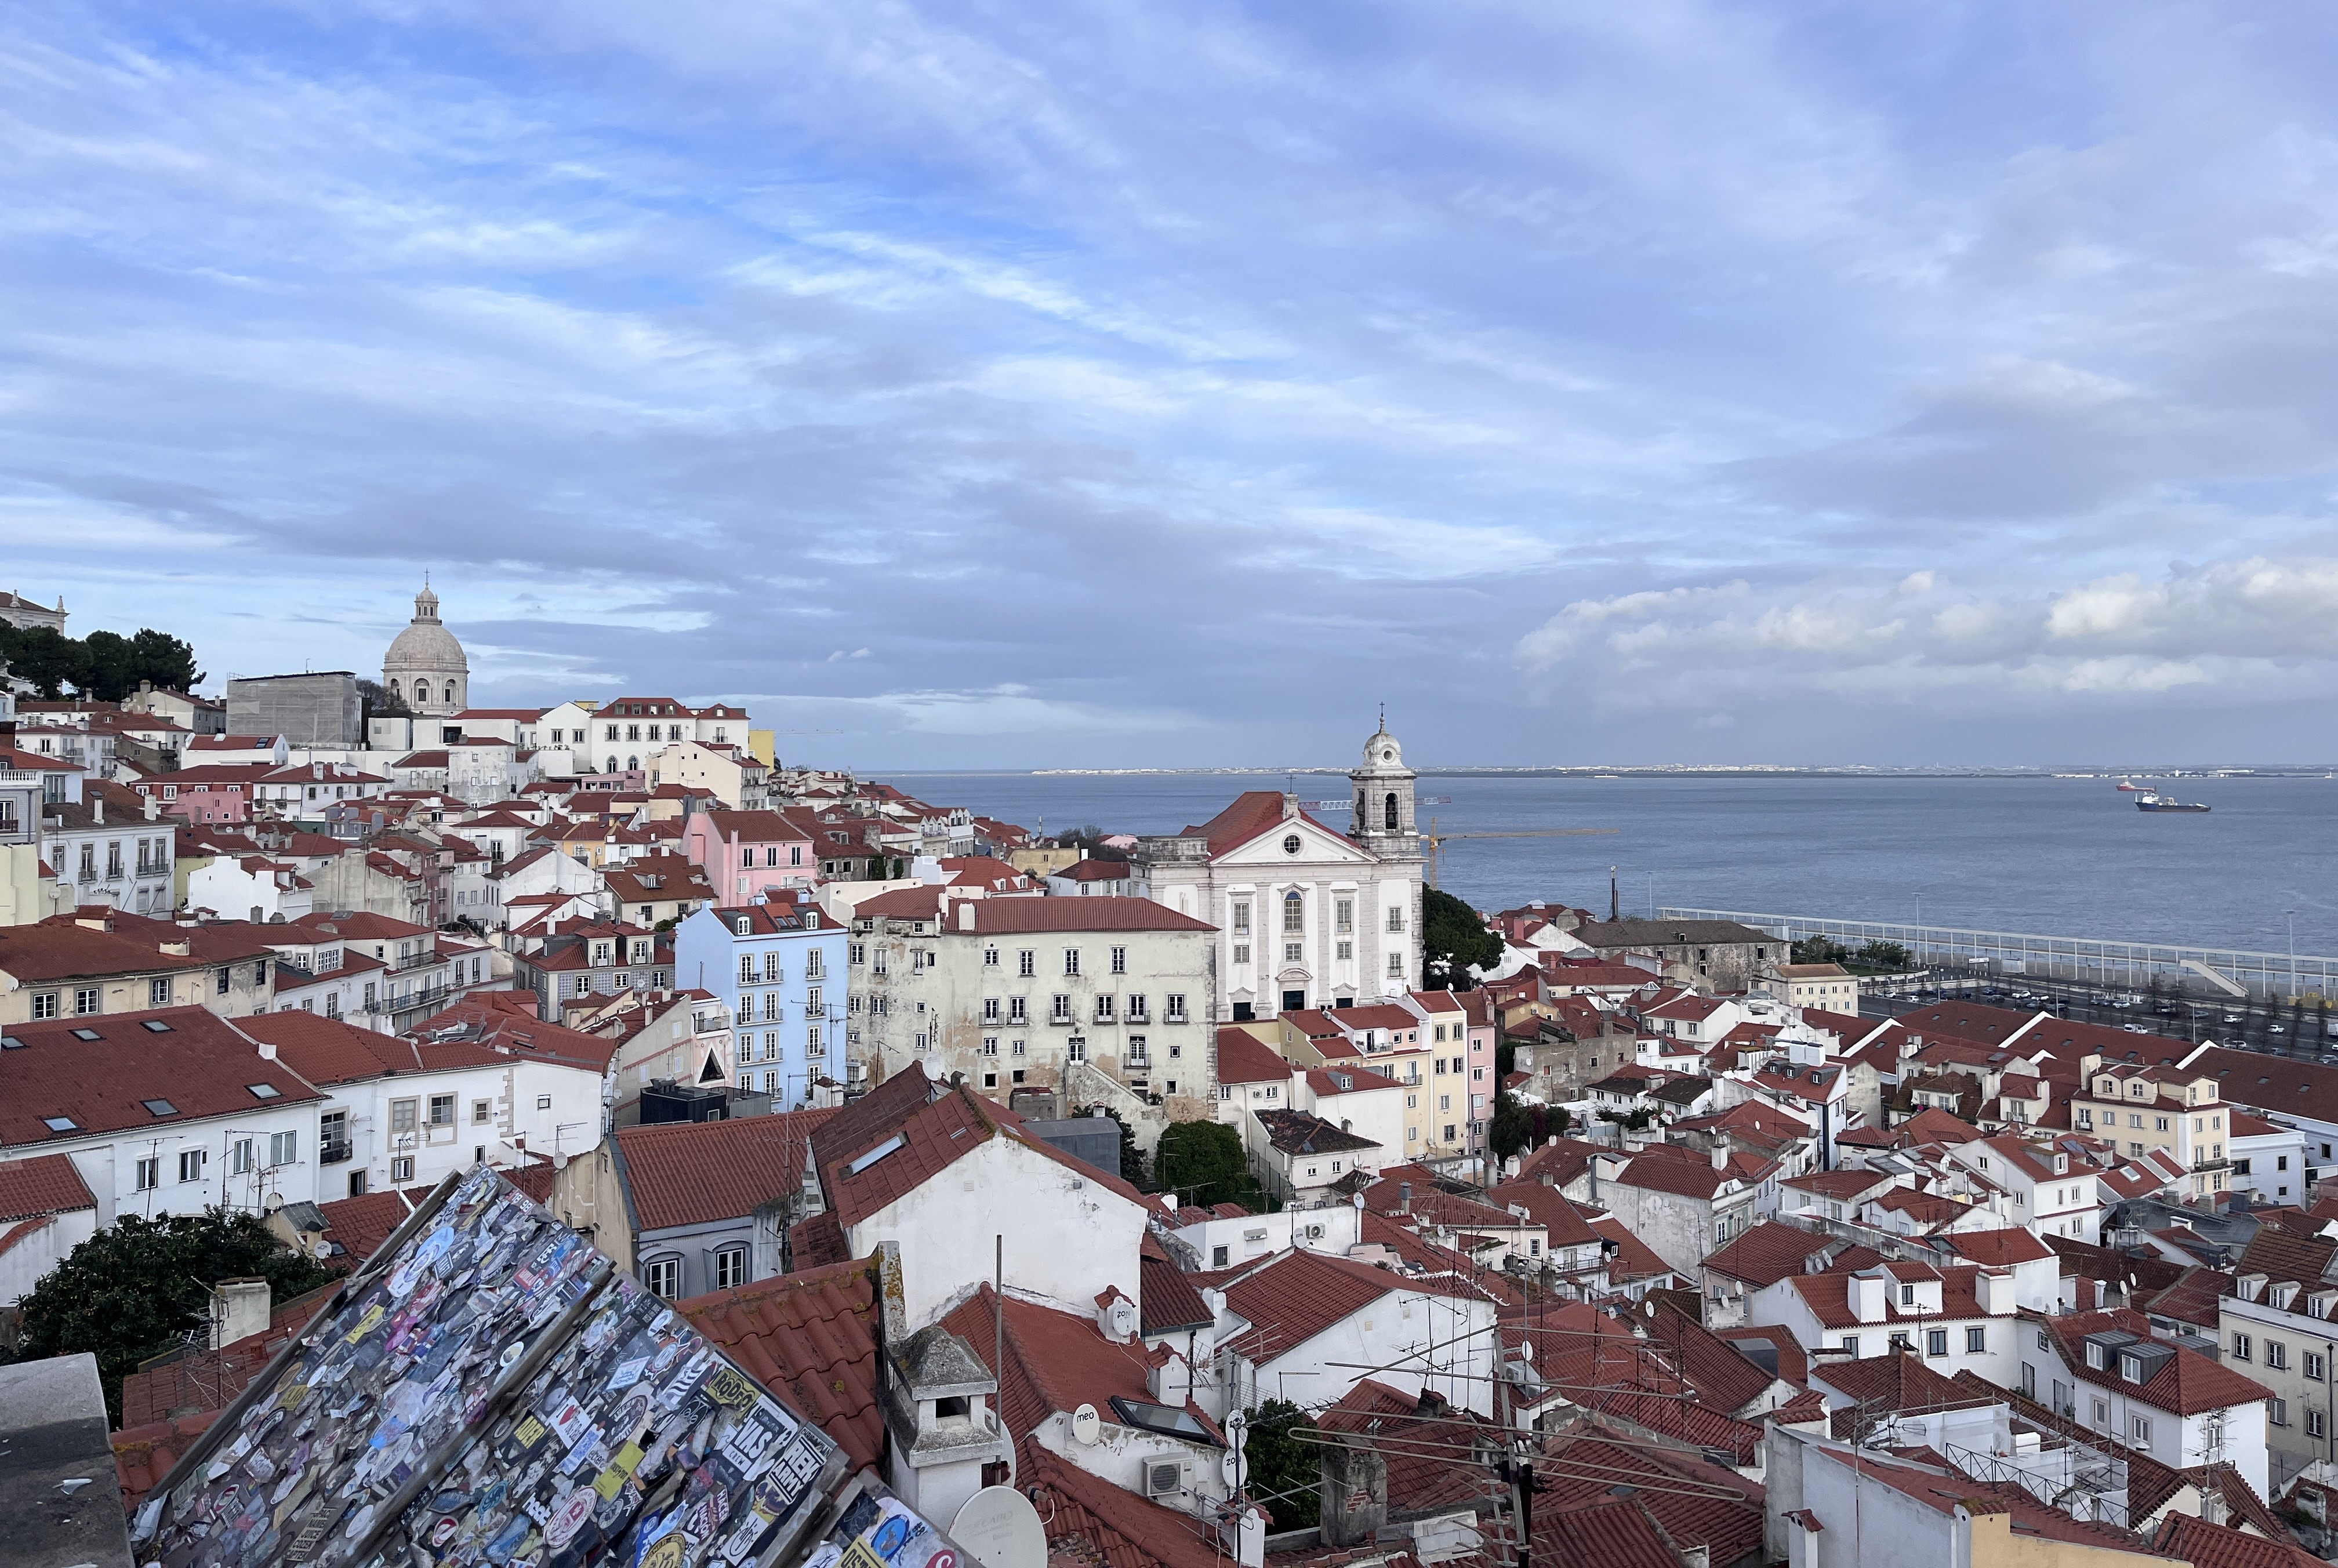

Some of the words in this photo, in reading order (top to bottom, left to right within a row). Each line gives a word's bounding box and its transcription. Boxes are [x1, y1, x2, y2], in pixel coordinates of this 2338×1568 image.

[1117, 1311, 1131, 1319] ZON
[713, 1371, 753, 1410] RODEO
[1077, 1412, 1094, 1422] meo
[734, 1417, 772, 1459] VAS
[729, 1450, 745, 1466] CREW
[785, 1446, 820, 1484] REK
[773, 1461, 804, 1497] ARMY
[717, 1489, 727, 1524] HACER
